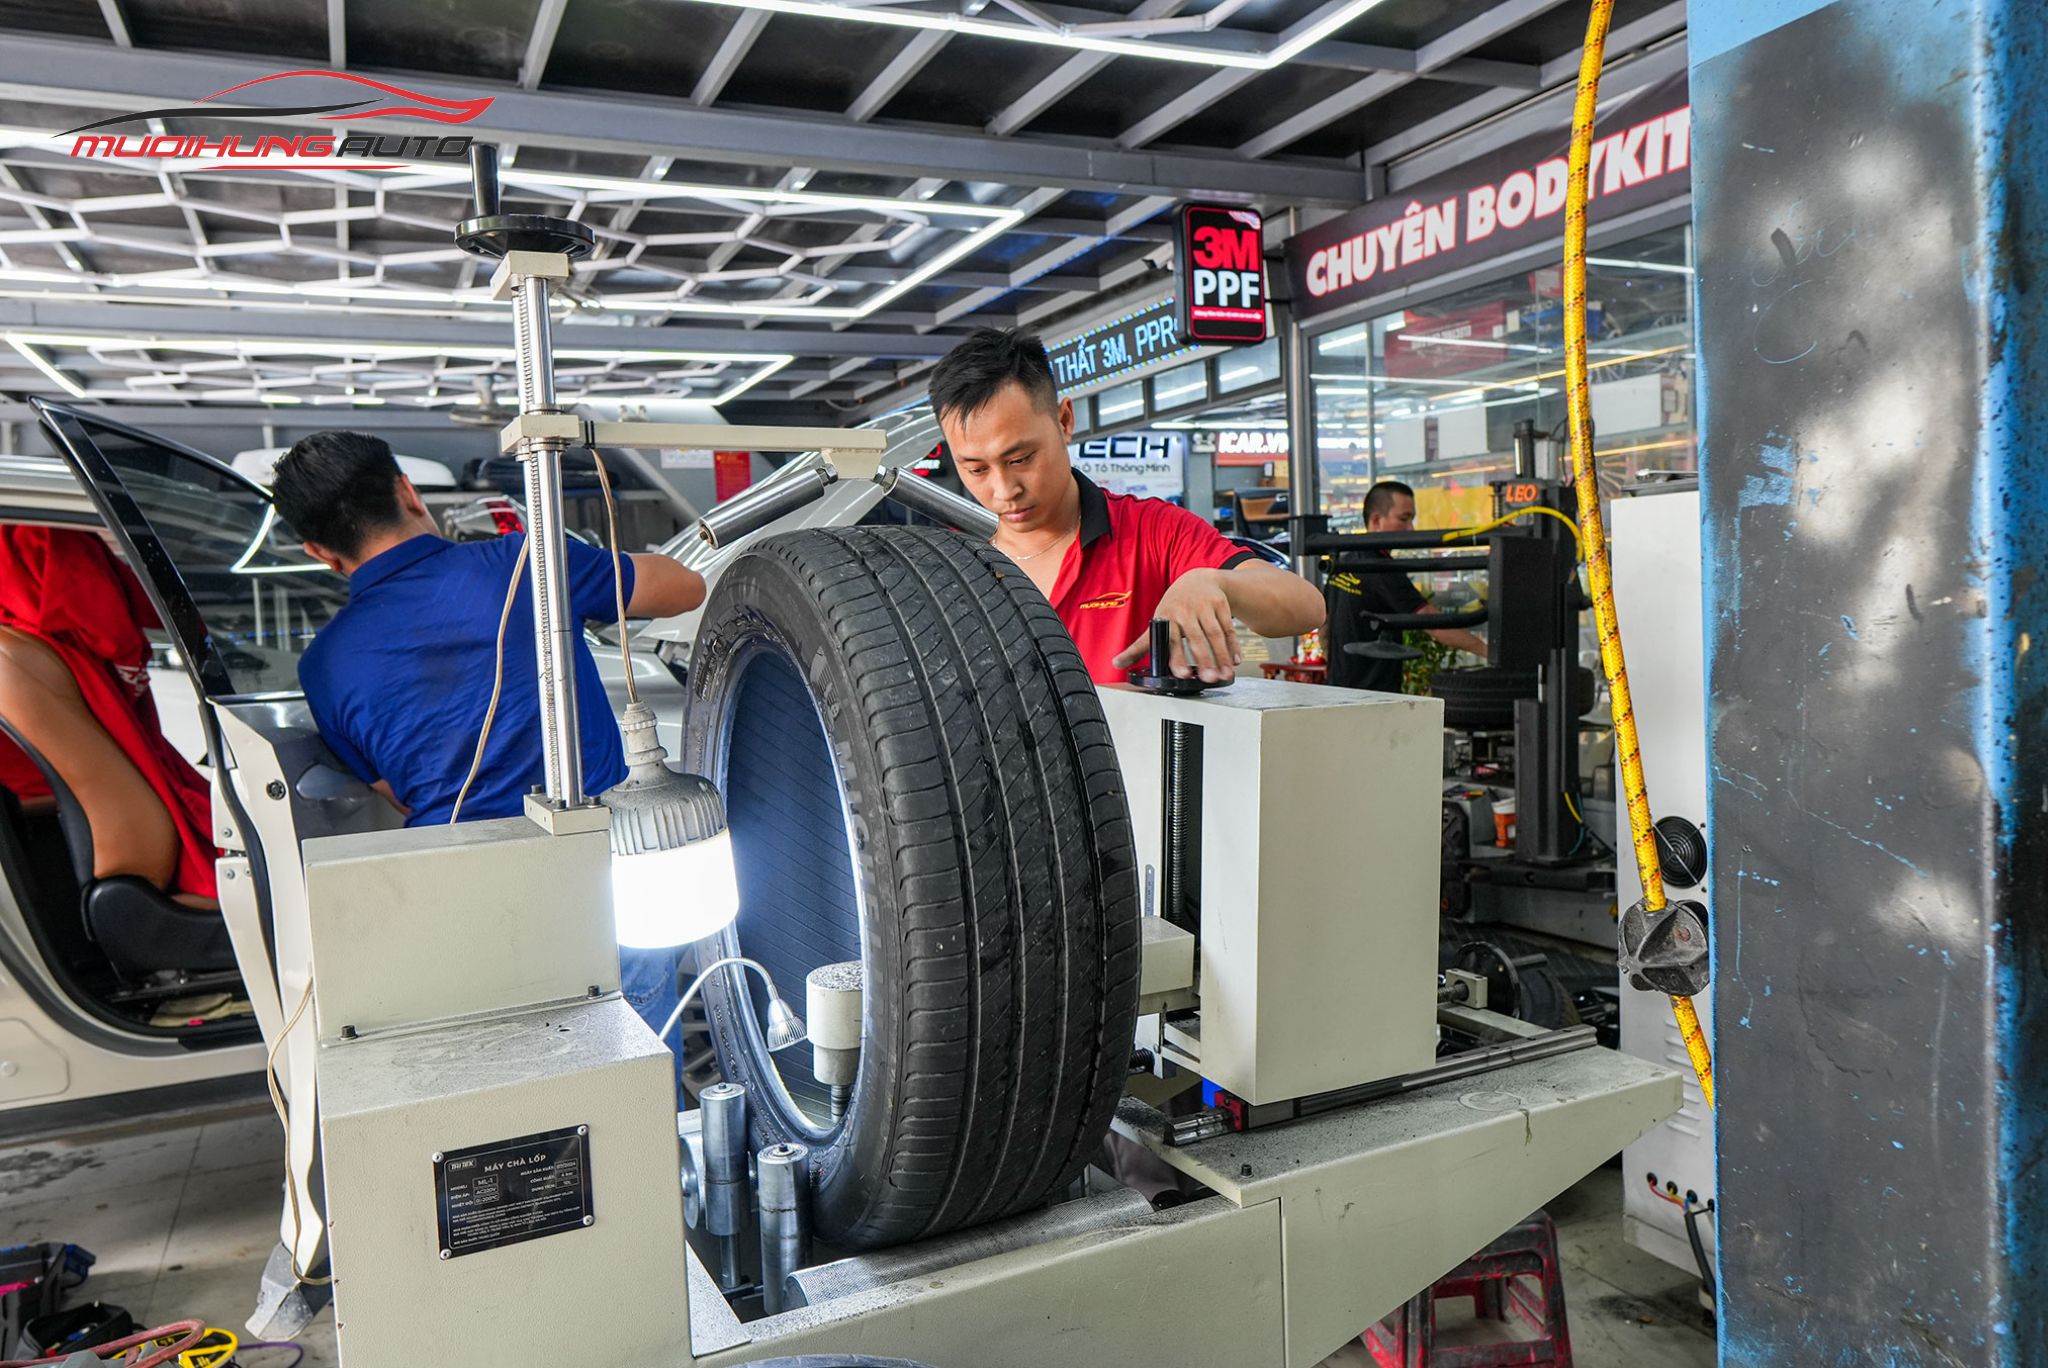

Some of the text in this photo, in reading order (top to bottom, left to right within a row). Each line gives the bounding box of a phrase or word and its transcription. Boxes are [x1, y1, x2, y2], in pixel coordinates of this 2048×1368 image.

[1193, 225, 1259, 271] 3M
[1306, 197, 1457, 297] CHUYÊN
[1193, 269, 1259, 308] PPF
[1054, 334, 1096, 384] THẤT
[1111, 463, 1145, 475] Thông
[1146, 463, 1170, 473] Minh
[1505, 483, 1537, 502] LEO
[484, 1153, 546, 1172] MÁY CHÀ LỐP
